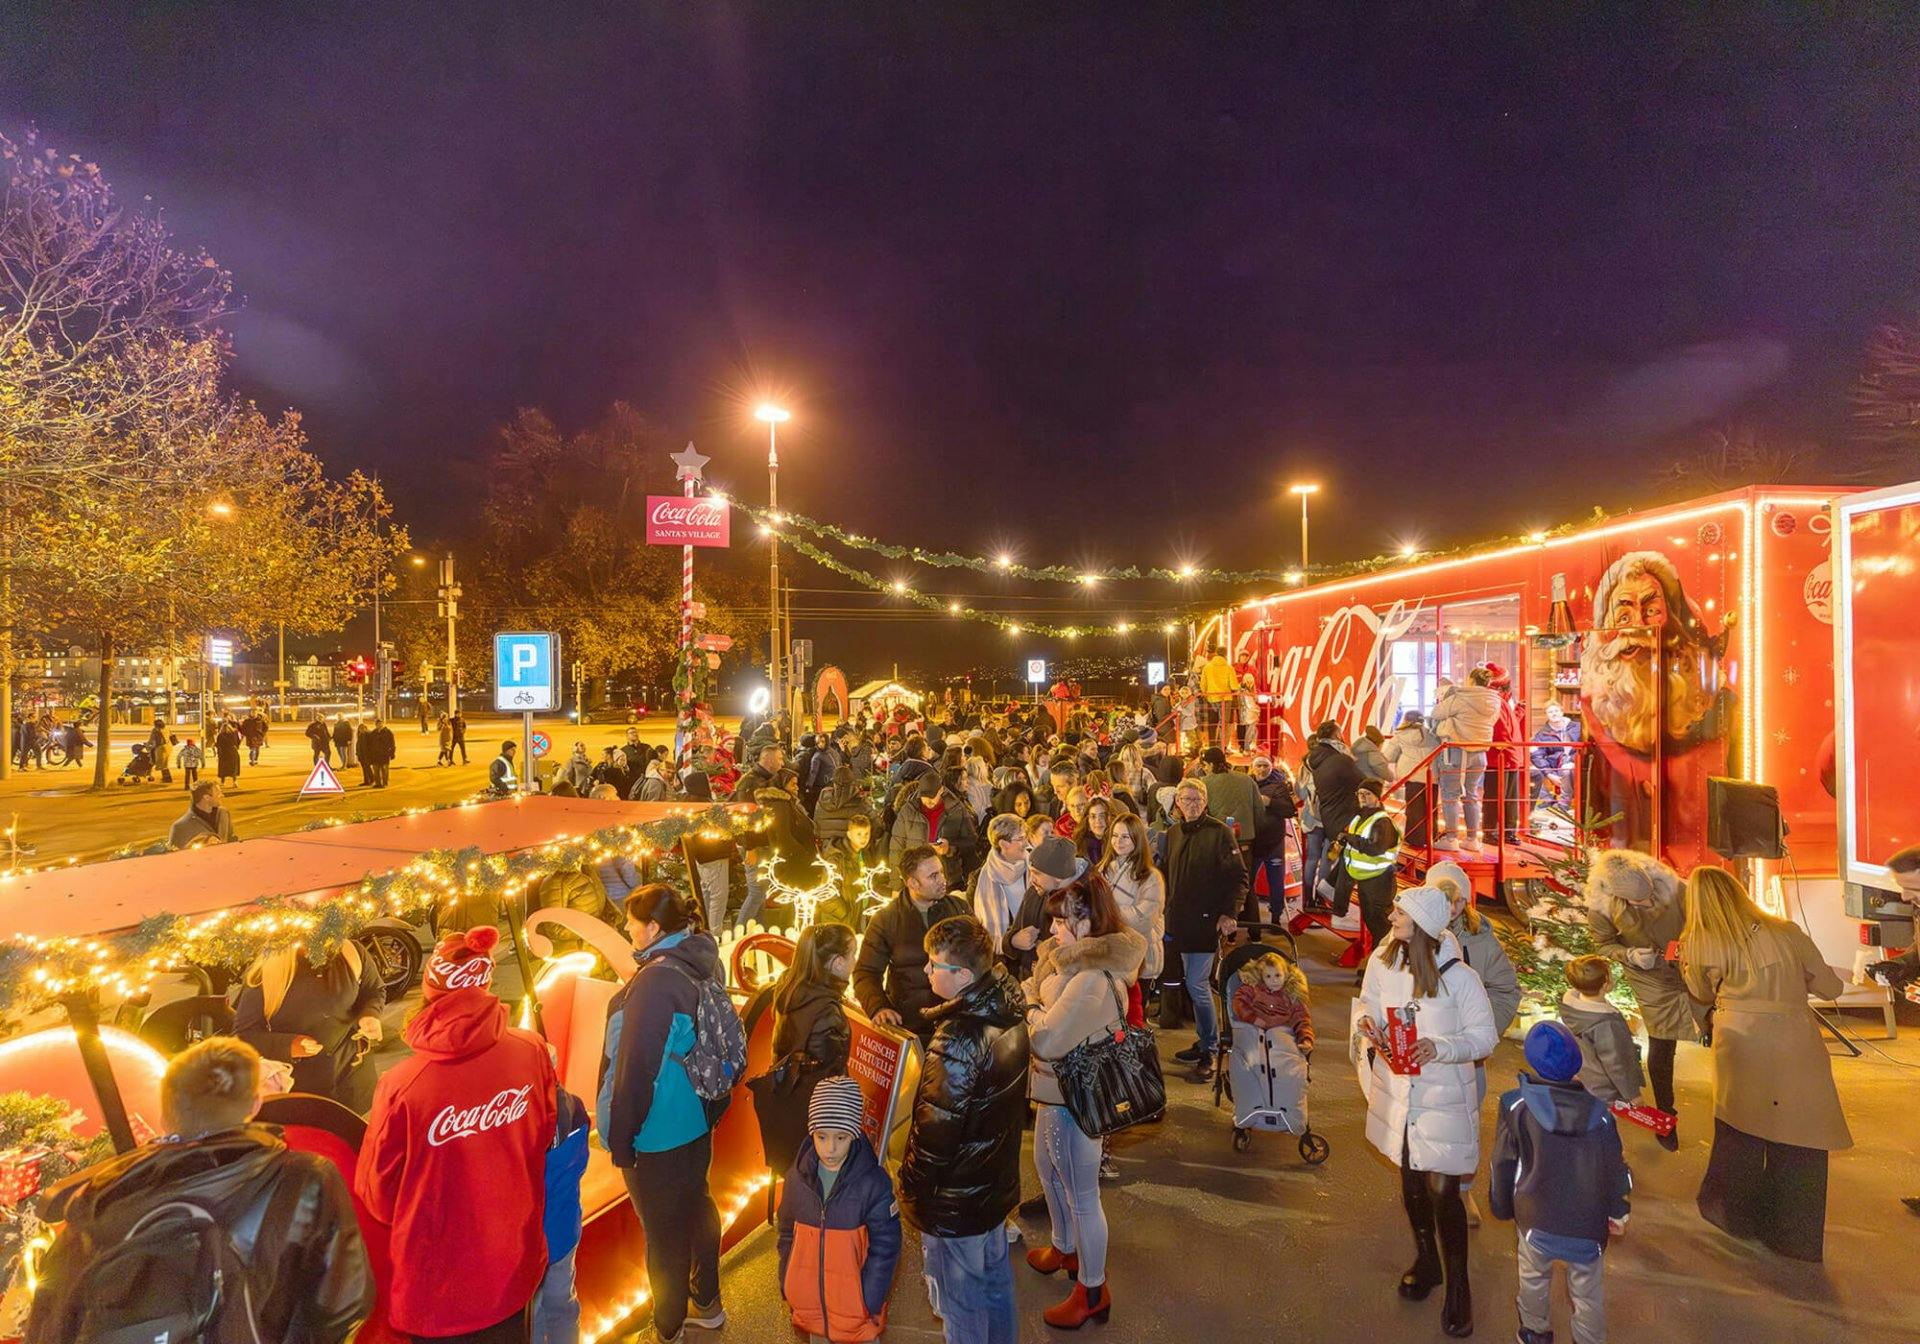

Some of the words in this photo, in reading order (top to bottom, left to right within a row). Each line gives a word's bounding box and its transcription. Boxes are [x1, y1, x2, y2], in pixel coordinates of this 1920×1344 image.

[652, 501, 722, 526] Coca-Cola
[655, 530, 687, 538] SANTA'S
[687, 531, 721, 539] VILLAGE
[512, 643, 538, 682] P
[1234, 596, 1424, 744] Ca-Cola
[856, 1047, 894, 1076] VIRTUELLE
[860, 1034, 897, 1062] MAGISCHE
[427, 1083, 534, 1147] Coca-Cola
